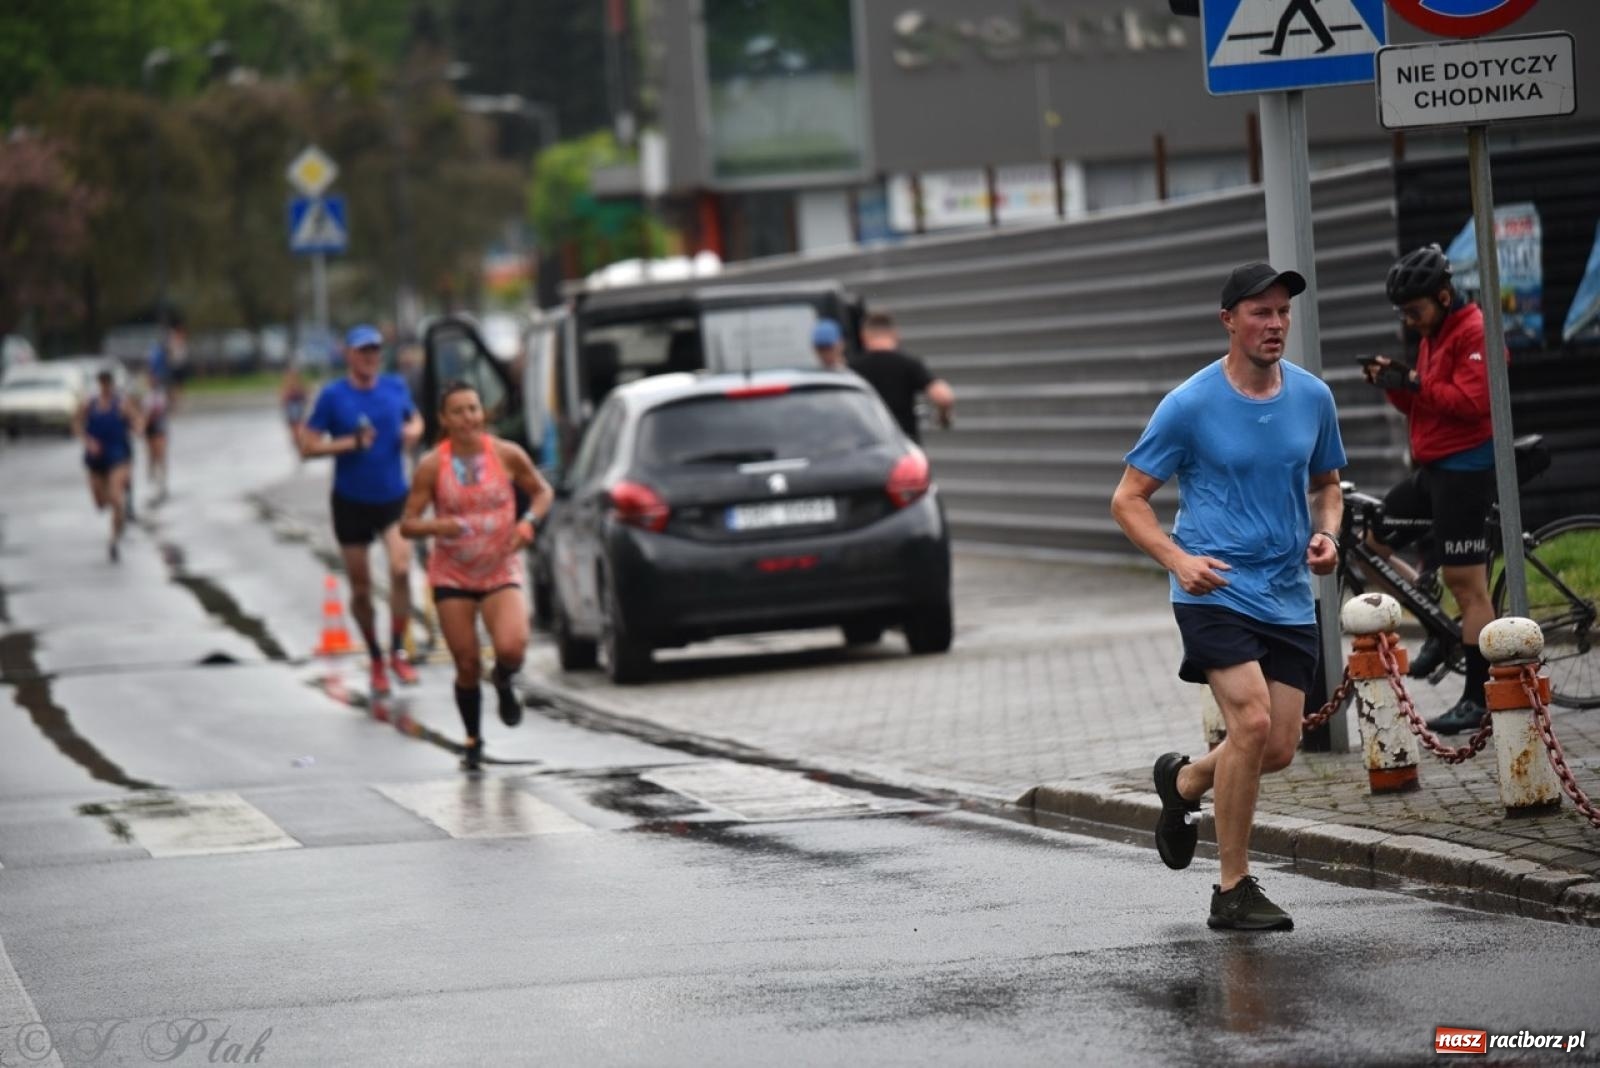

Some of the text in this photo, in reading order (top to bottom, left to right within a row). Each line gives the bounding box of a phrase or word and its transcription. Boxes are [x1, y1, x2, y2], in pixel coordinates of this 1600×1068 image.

[1397, 54, 1558, 84] NIE DOTYCZY
[1414, 82, 1543, 109] CHODNIKA
